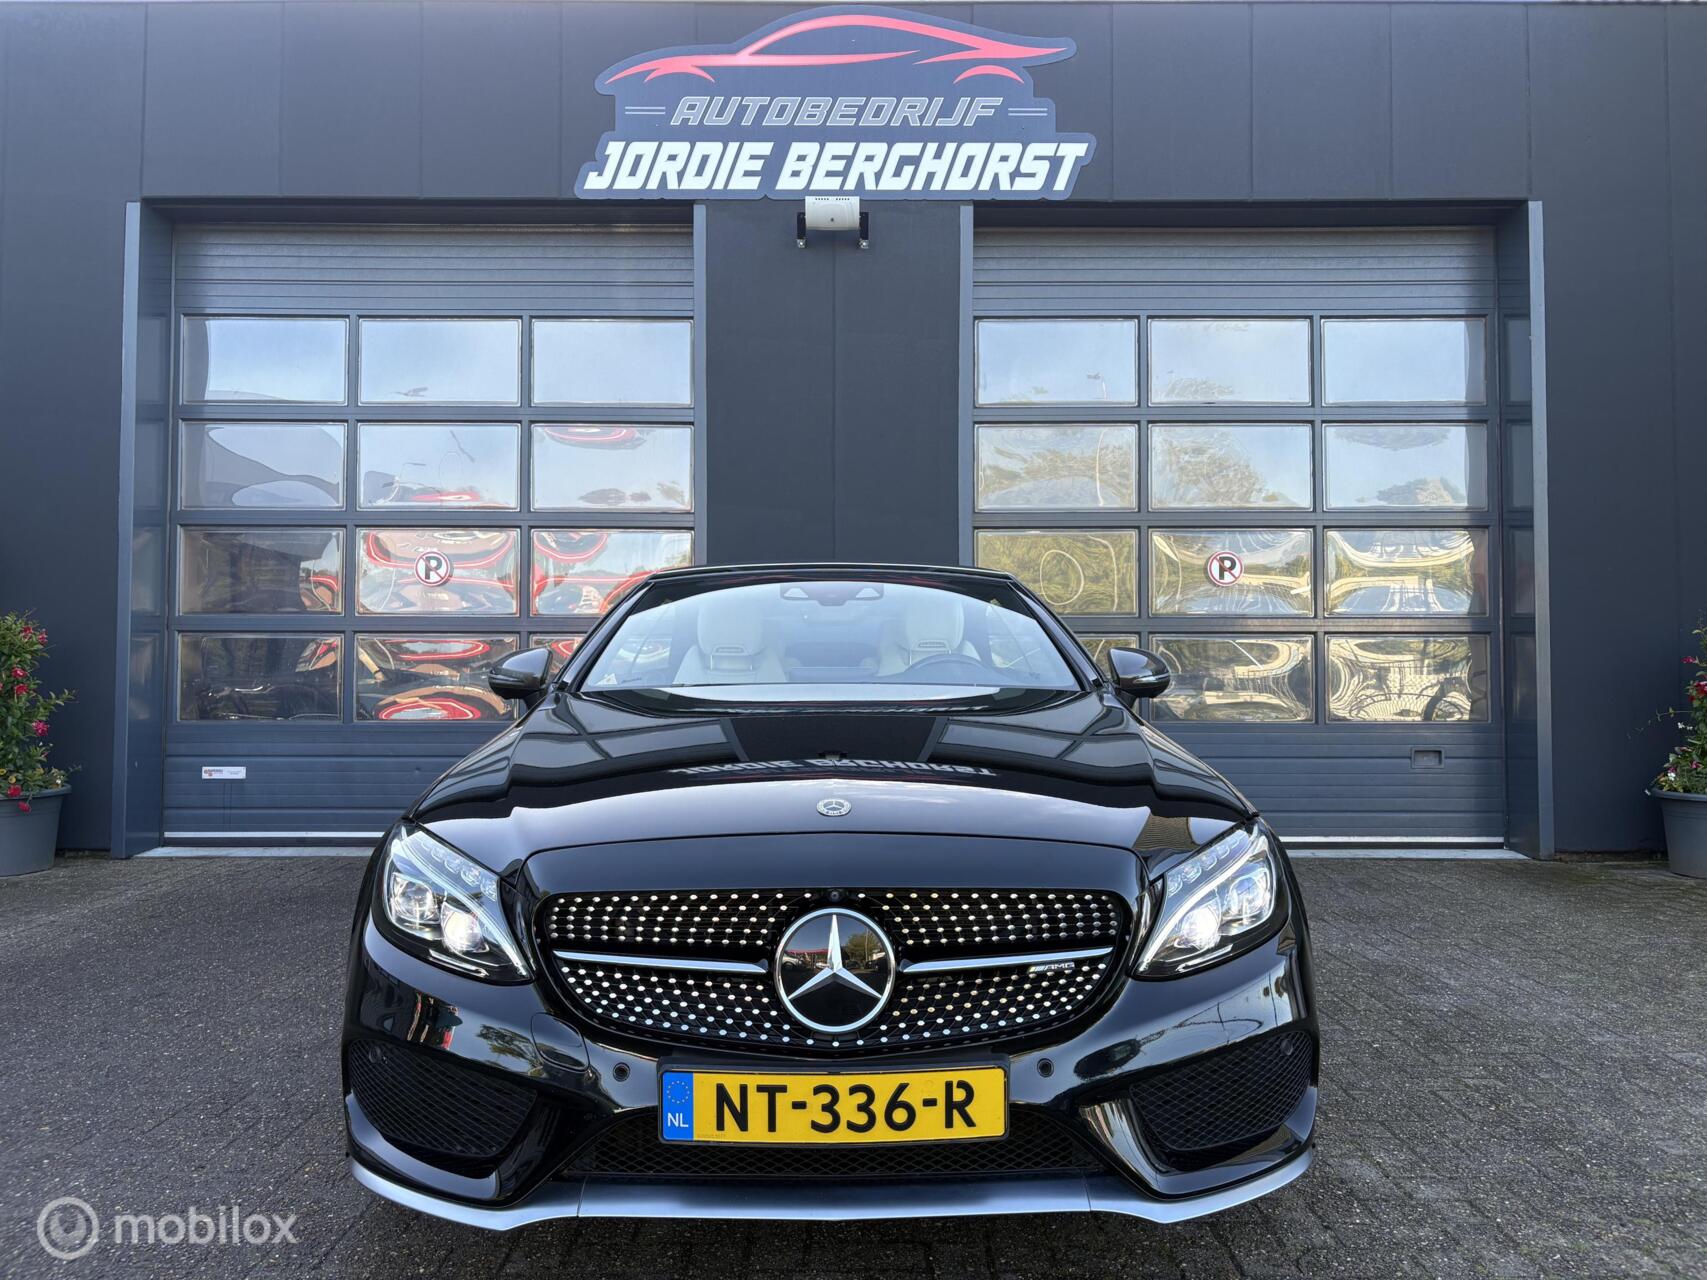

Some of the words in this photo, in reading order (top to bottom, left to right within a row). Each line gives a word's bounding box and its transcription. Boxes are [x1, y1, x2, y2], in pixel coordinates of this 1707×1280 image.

[670, 96, 1004, 126] AUTOBEDRIJF
[583, 141, 775, 190] JORDIE
[775, 141, 1089, 191] BERGHORST
[425, 556, 443, 580] P
[1219, 556, 1237, 580] P
[667, 1112, 689, 1128] NL
[715, 1080, 977, 1133] NT-336-R
